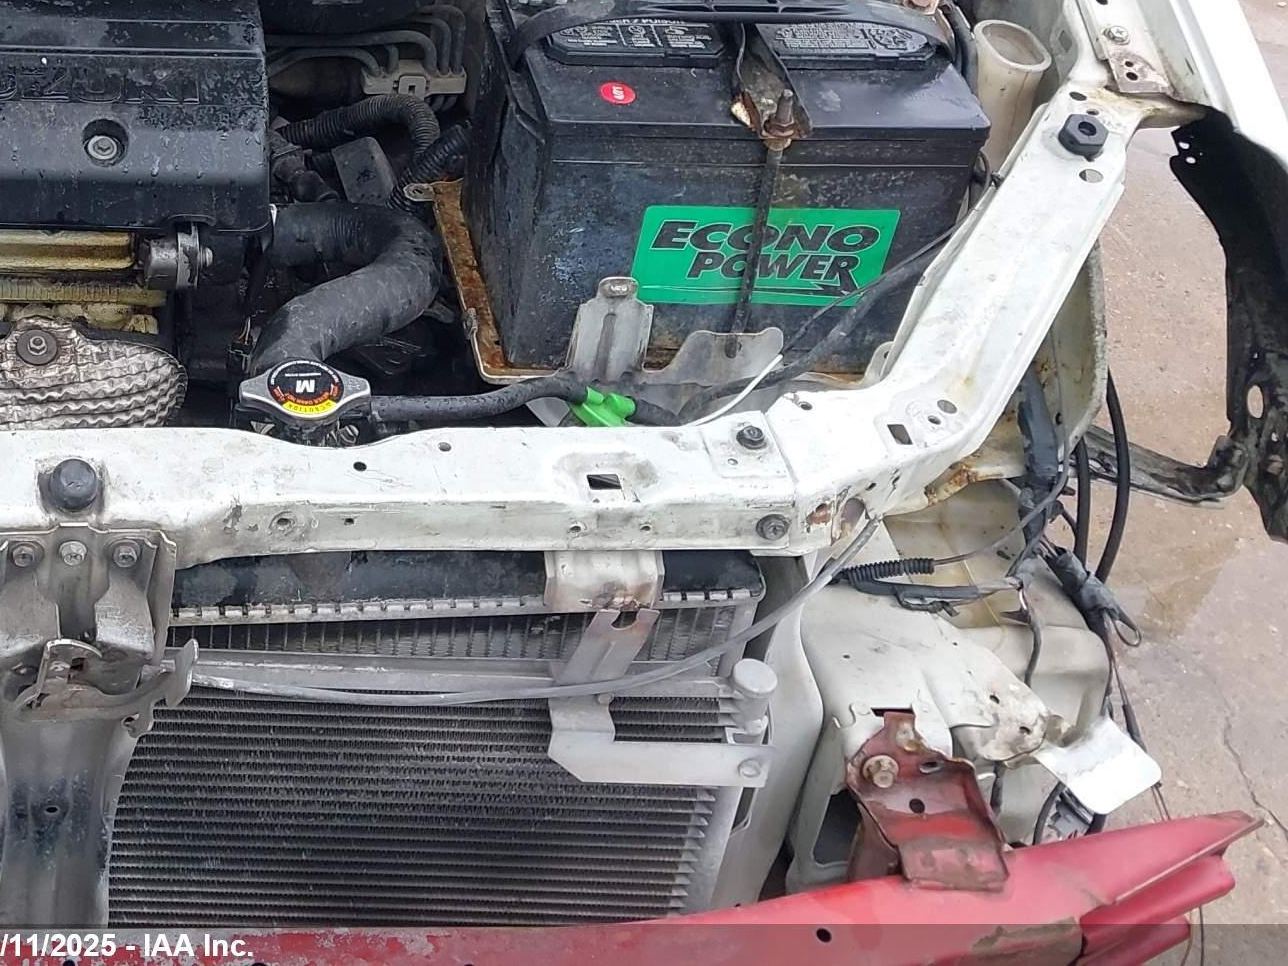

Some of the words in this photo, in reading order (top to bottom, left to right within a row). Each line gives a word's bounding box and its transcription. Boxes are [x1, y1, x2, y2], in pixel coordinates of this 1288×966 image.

[649, 219, 881, 253] ECONO
[686, 250, 862, 288] POWER
[288, 402, 327, 413] CAUTION
